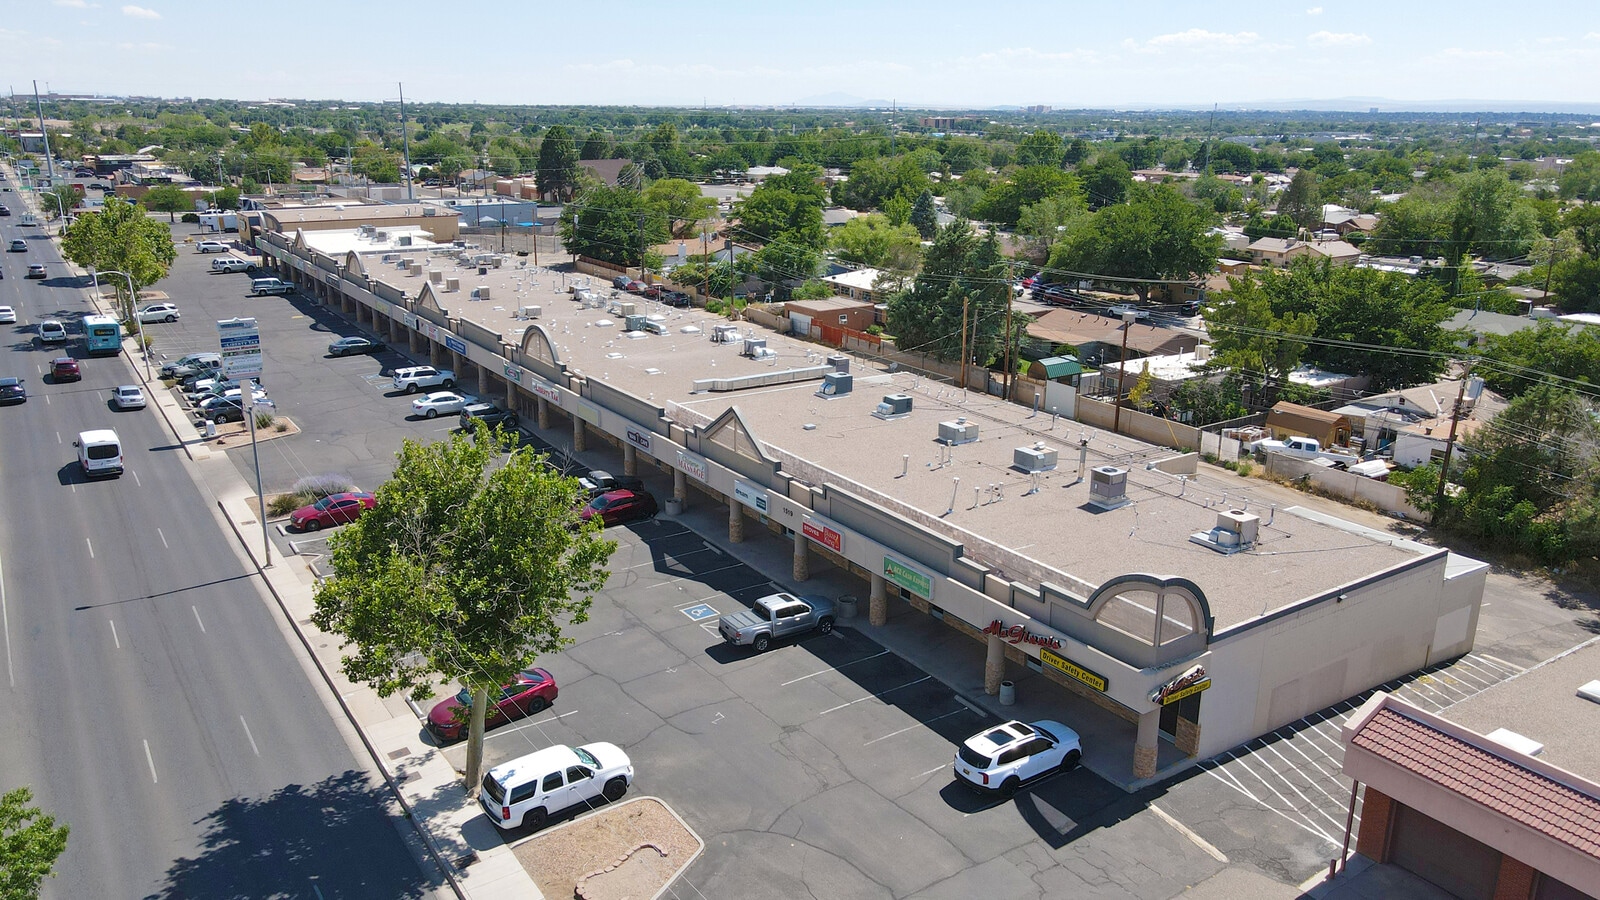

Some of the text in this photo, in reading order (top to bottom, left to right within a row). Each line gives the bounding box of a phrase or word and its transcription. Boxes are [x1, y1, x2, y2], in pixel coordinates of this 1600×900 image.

[1042, 652, 1103, 689] Driver Safety Center
